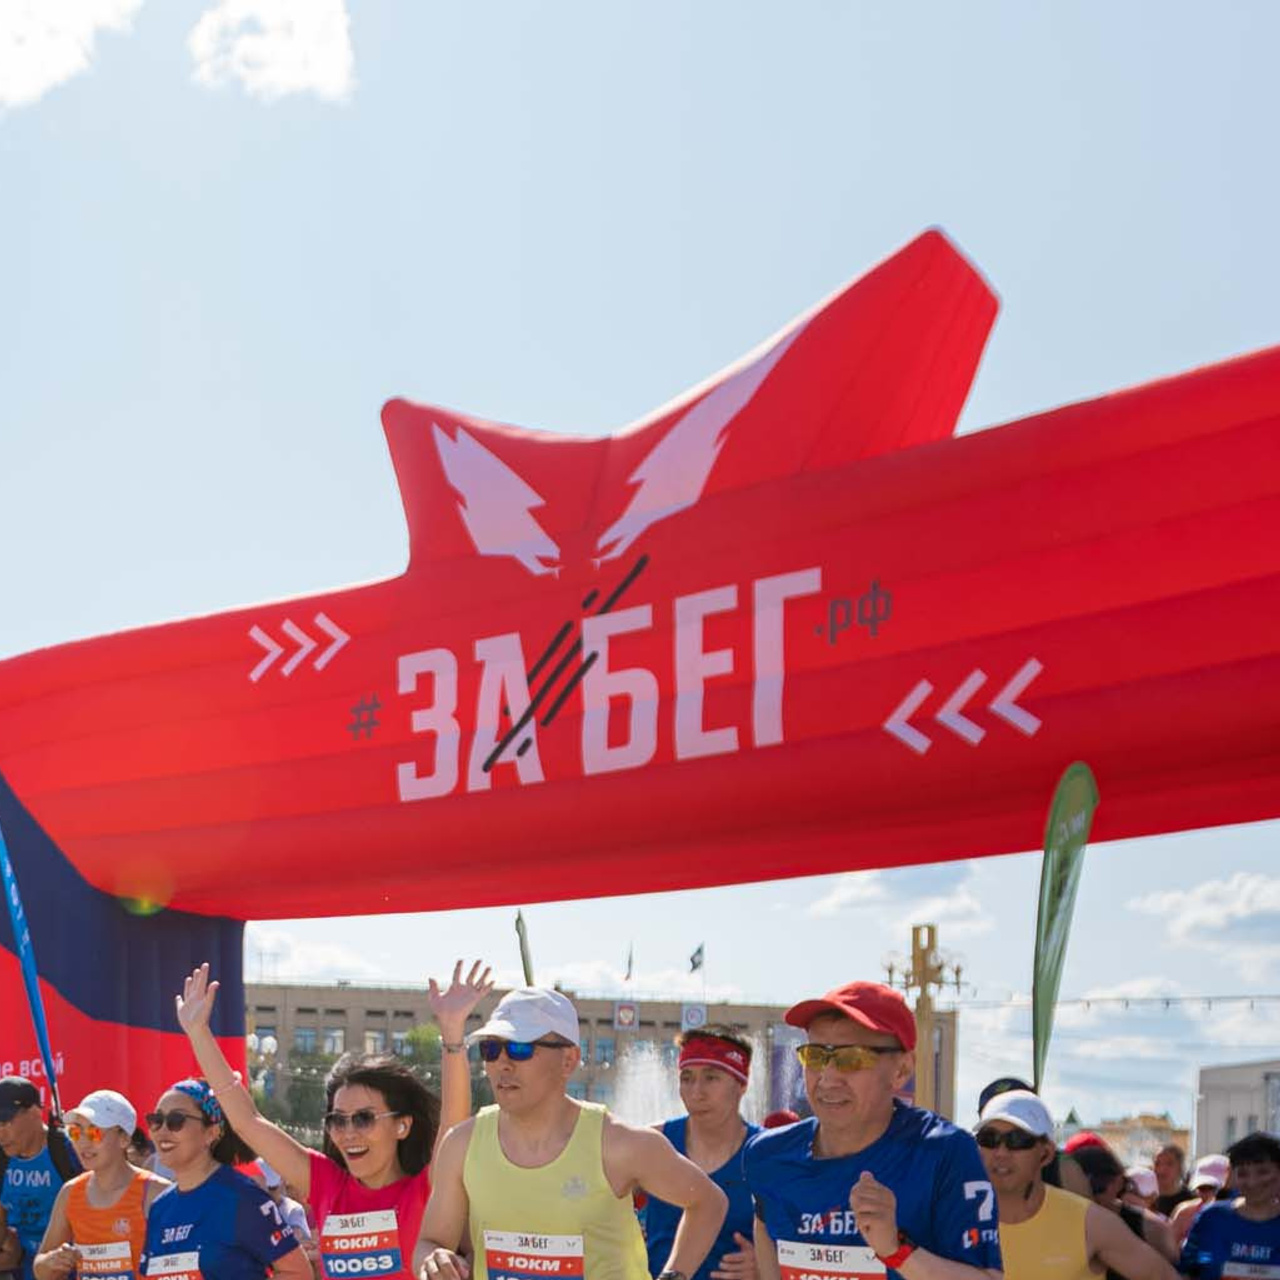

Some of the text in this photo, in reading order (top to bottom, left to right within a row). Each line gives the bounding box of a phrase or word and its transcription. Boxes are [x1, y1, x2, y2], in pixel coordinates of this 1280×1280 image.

[20, 1052, 64, 1078] всй
[6, 1168, 23, 1186] 10
[963, 1181, 995, 1221] 7
[327, 1255, 394, 1273] 10063
